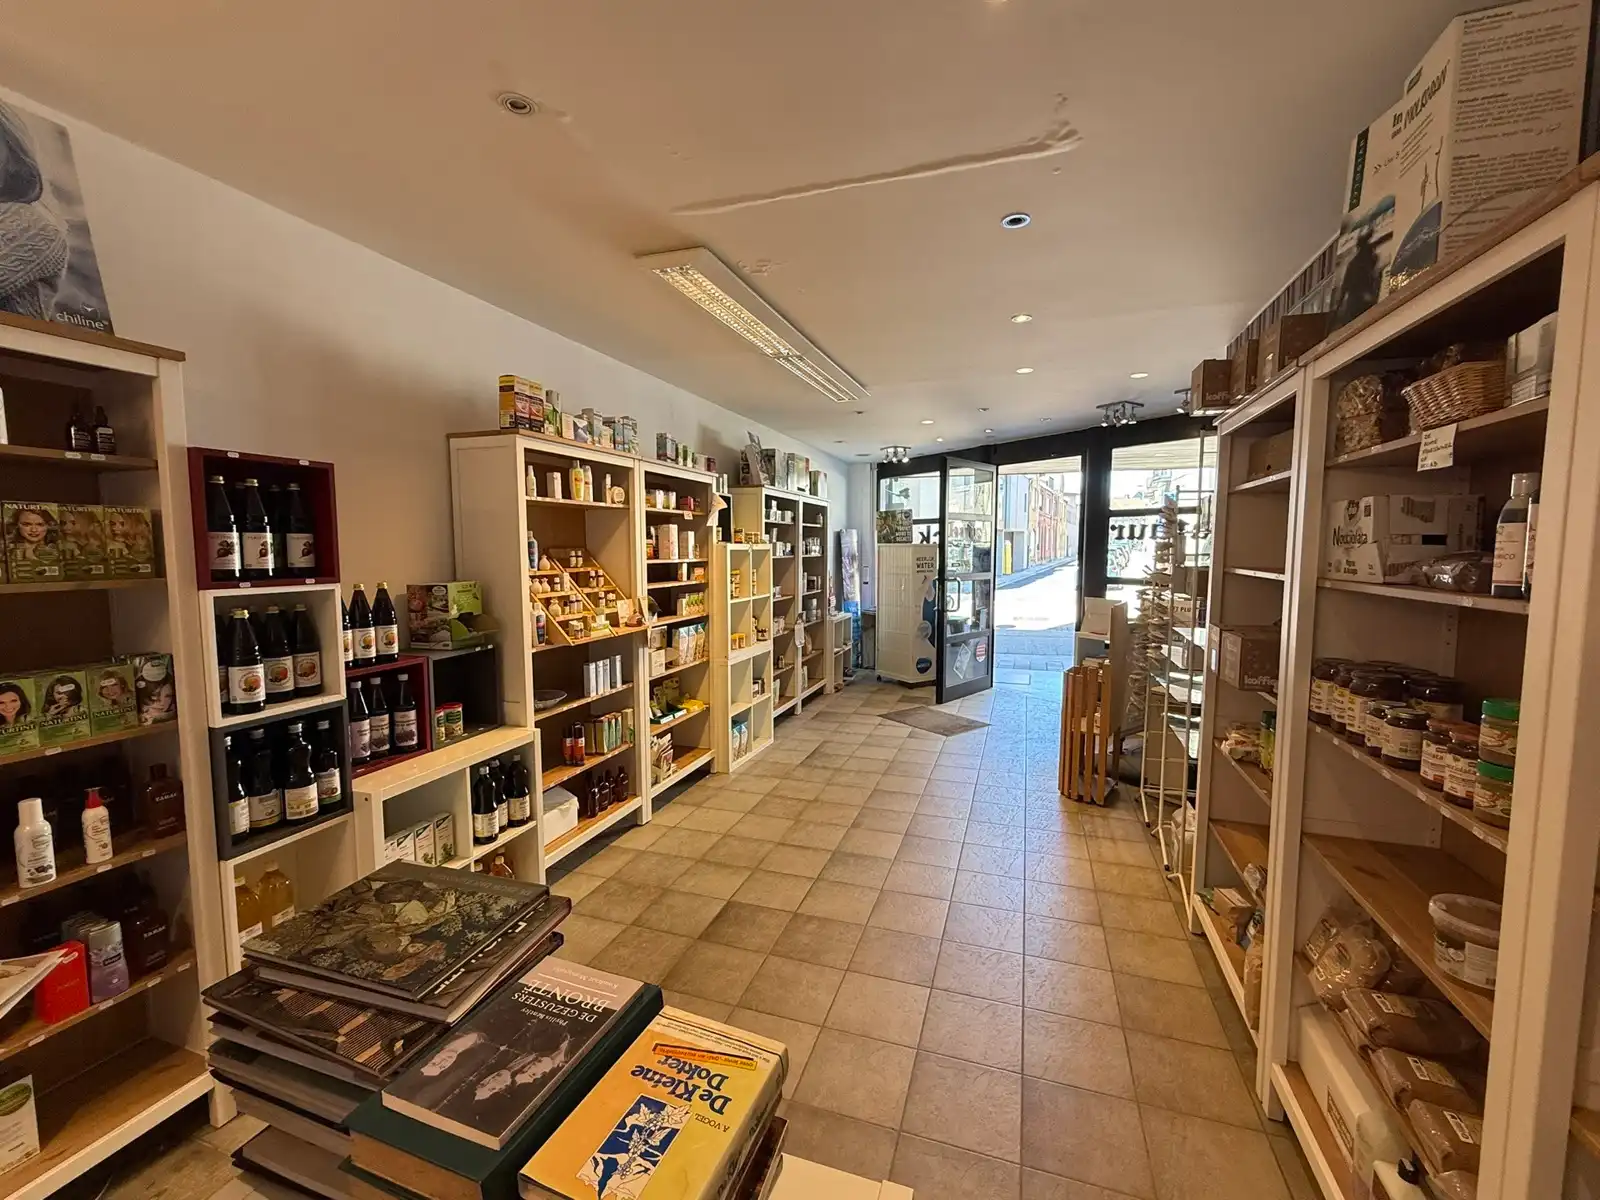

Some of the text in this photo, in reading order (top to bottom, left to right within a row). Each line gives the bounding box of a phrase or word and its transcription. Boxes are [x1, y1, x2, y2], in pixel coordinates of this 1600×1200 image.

[56, 312, 104, 330] chiline
[511, 992, 598, 1023] DE GEZUSTERS
[521, 980, 612, 1013] BRONTË
[656, 1055, 730, 1092] Dokter
[630, 1064, 733, 1116] De Kleine
[694, 1113, 721, 1129] VOGEL
